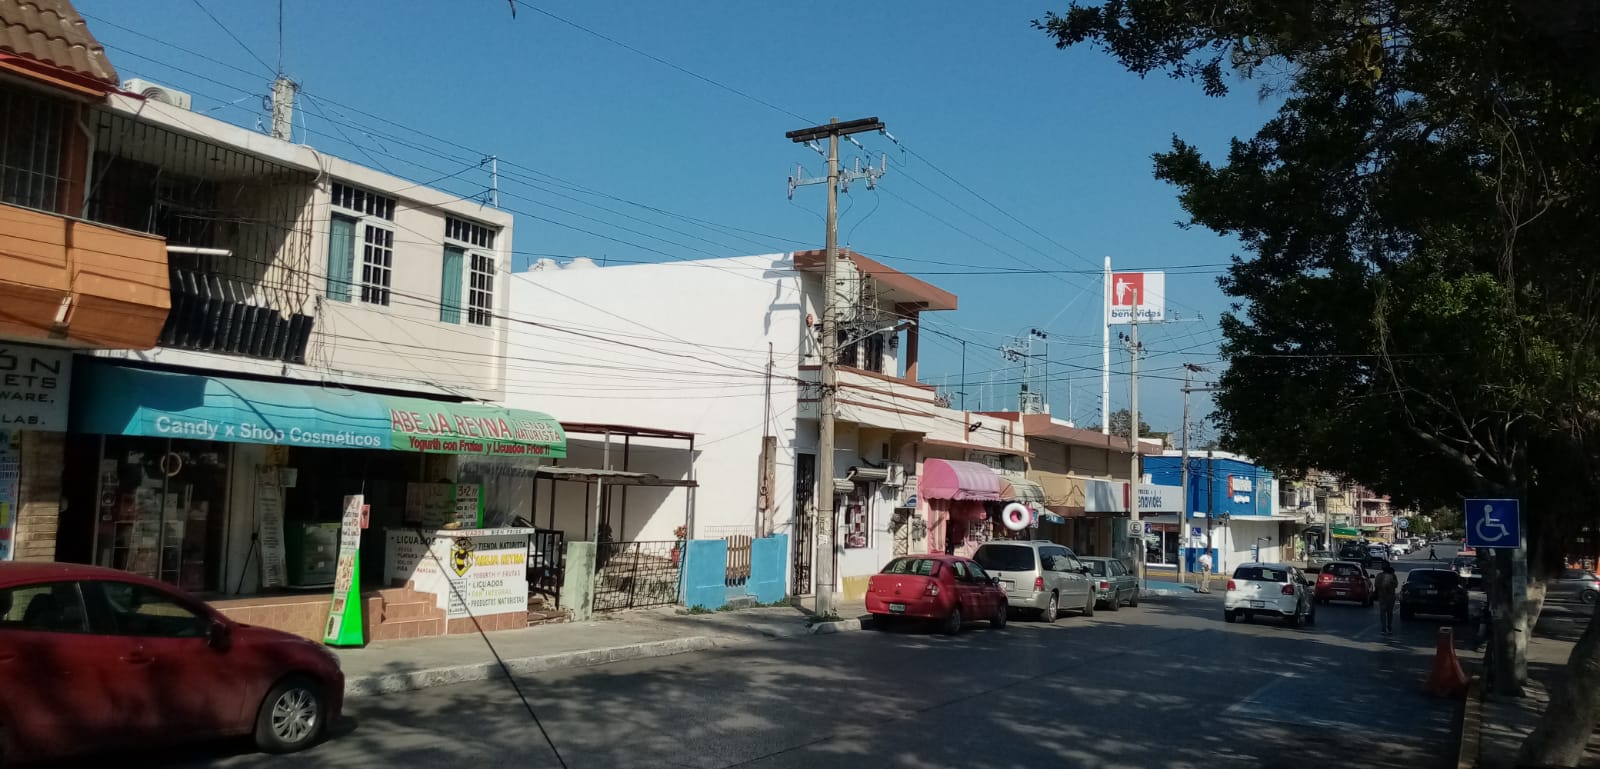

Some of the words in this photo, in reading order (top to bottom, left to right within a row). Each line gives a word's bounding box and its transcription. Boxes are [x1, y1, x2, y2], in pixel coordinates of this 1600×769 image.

[4, 374, 57, 389] ETS
[2, 414, 46, 425] LAB.
[390, 408, 453, 435] ABEJA
[452, 413, 513, 440] REYNA
[513, 420, 553, 431] TIENDA
[240, 422, 285, 444] Shop
[290, 427, 382, 447] Cosméticos
[514, 428, 563, 442] NATURISTA
[442, 442, 458, 451] con
[459, 440, 484, 452] Frutas
[486, 443, 492, 455] y
[493, 441, 525, 454] Licuados
[473, 579, 503, 589] LICUADOS
